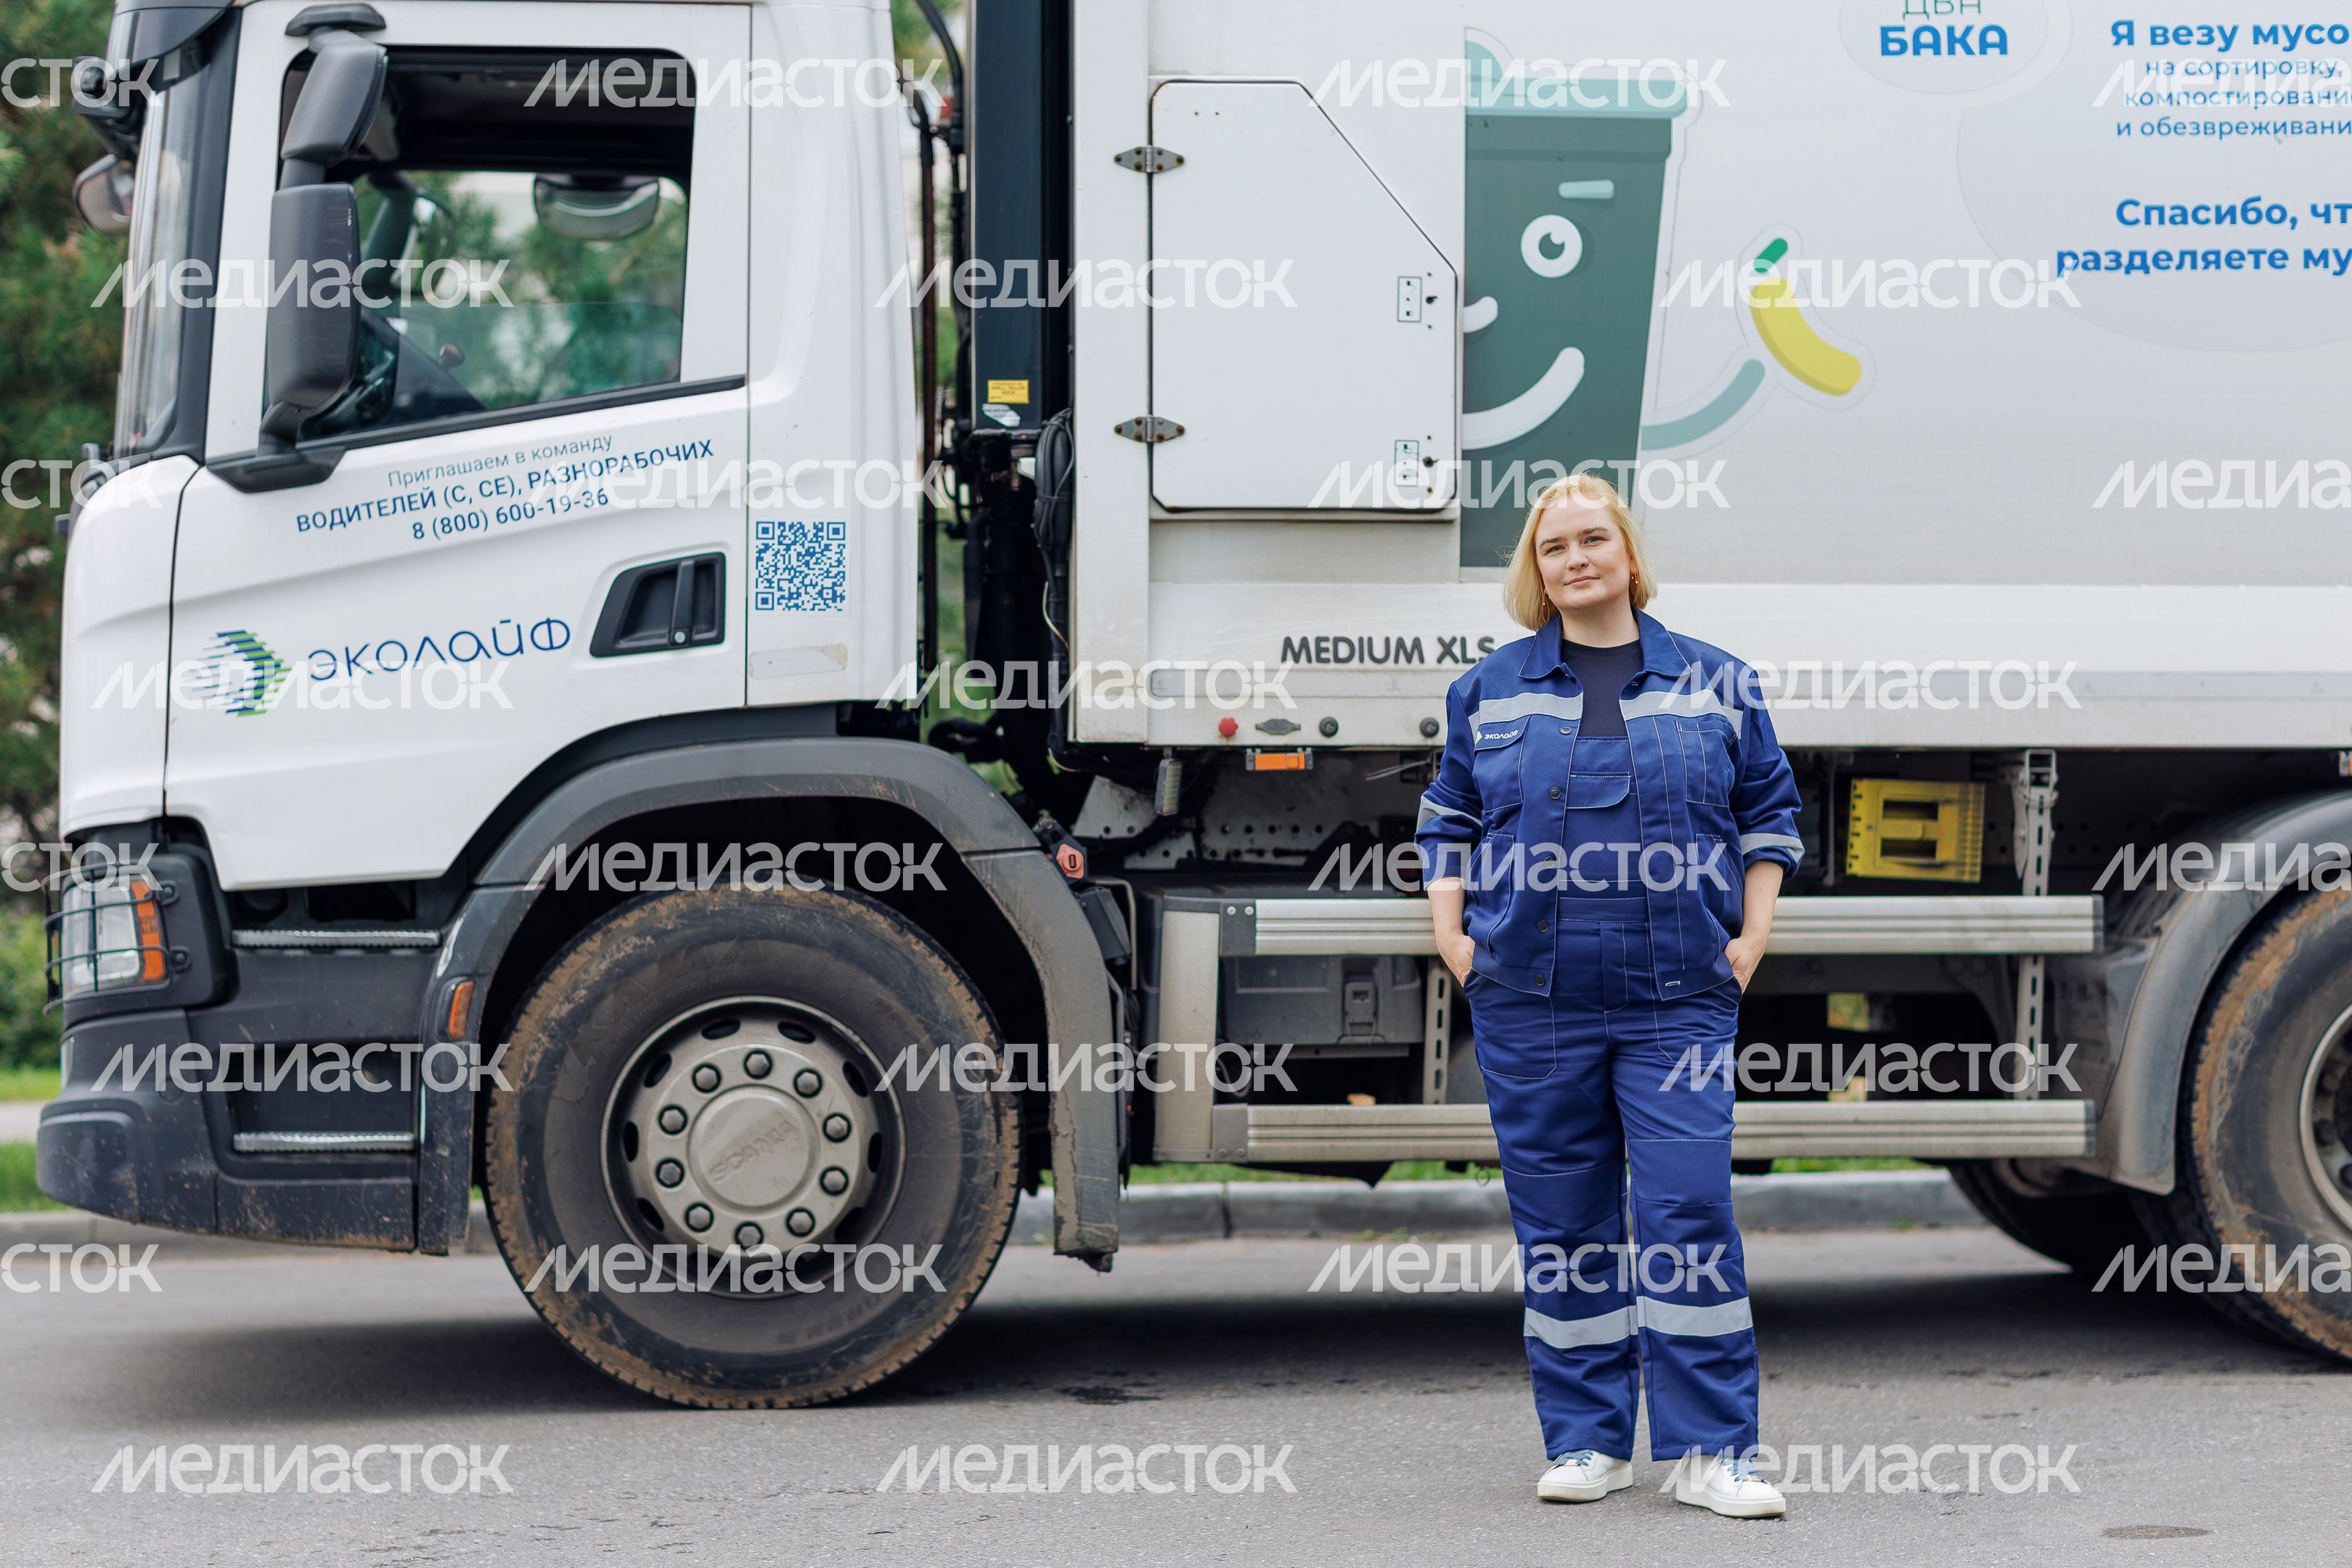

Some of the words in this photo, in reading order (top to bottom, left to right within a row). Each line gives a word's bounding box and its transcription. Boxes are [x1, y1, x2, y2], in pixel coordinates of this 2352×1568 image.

[1880, 25, 2008, 56] БАКА
[2111, 20, 2135, 46] Я
[2149, 24, 2239, 52] везу
[2253, 23, 2350, 52] мусо
[2146, 61, 2175, 75] на
[2184, 60, 2343, 80] сортировку,
[2126, 90, 2352, 111] компостировани
[2117, 121, 2131, 136] и
[2116, 195, 2298, 230] Спасибо,
[2057, 248, 2289, 278] разделяете
[388, 454, 509, 488] Приглашаем
[515, 452, 526, 464] в
[531, 436, 613, 461] команду
[296, 486, 436, 532] ВОДИТЕЛЕЙ
[528, 438, 714, 489] РАЗНОРАБОЧИХ
[412, 521, 425, 539] 8
[432, 509, 489, 540] (800)
[496, 487, 609, 524] 600-19-36
[1281, 636, 1425, 664] MEDIUM
[1437, 636, 1495, 664] XLS
